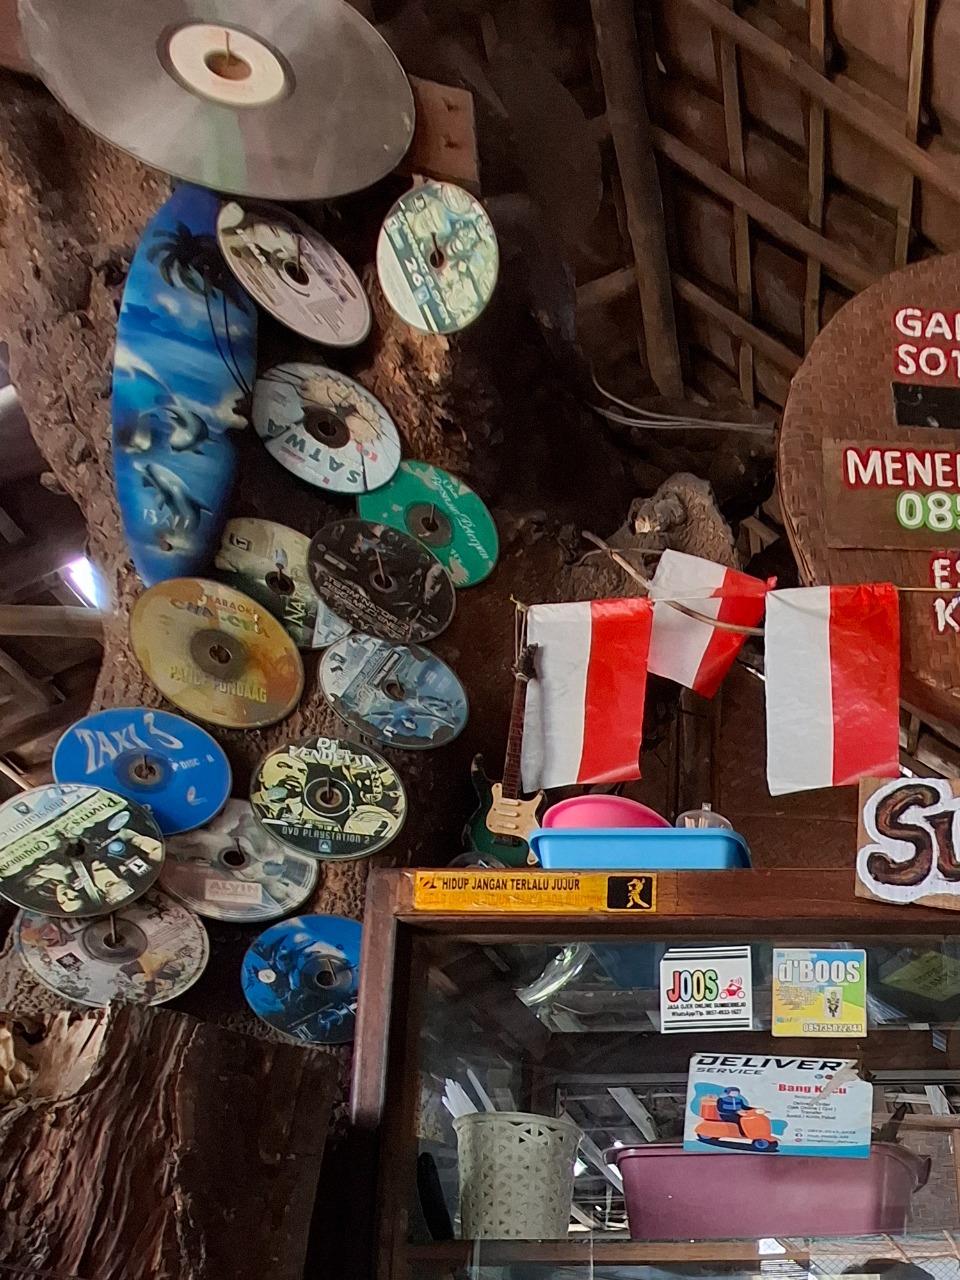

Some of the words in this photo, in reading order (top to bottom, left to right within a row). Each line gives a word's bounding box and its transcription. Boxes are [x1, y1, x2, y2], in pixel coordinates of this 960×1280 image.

[267, 418, 362, 484] SATWA
[74, 722, 153, 774] TAXI
[281, 826, 299, 836] DVD
[302, 827, 362, 844] PLAYSTATION
[441, 877, 470, 891] HIDUP
[471, 877, 508, 891] JANGAN
[510, 878, 549, 891] TERLALU
[551, 878, 580, 891] JUJUR
[777, 958, 862, 984] d'BOOS
[666, 968, 719, 1003] JOOS
[695, 1055, 850, 1072] DELIVER
[695, 1067, 764, 1076] SERVICE
[778, 1083, 811, 1094] Bang
[814, 1085, 847, 1094] Kcu
